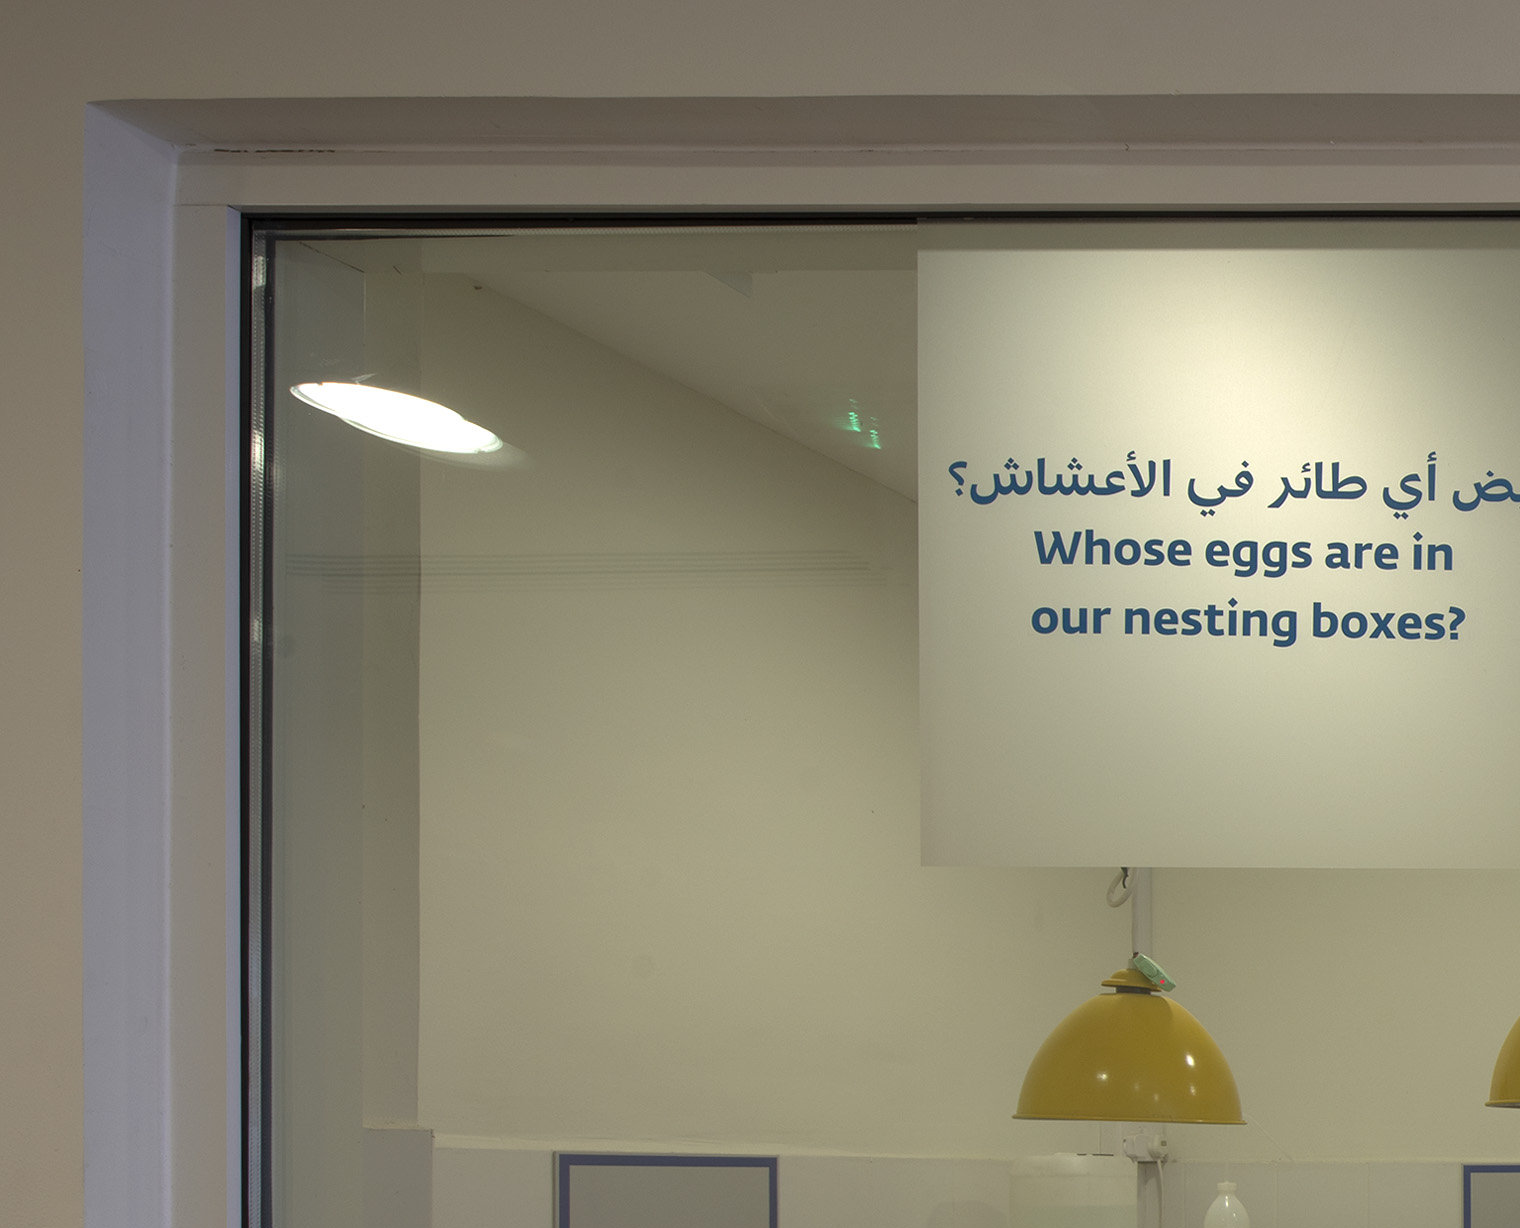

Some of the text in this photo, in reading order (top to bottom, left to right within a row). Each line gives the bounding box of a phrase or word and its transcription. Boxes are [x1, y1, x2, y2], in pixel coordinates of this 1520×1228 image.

[948, 451, 1170, 505] الأعشاش؟
[1188, 461, 1253, 517] في
[1268, 462, 1367, 508] طائر
[1383, 451, 1437, 519] أي
[1034, 529, 1452, 578] Whose eggs are in
[1032, 598, 1465, 647] our nesting boxes?
